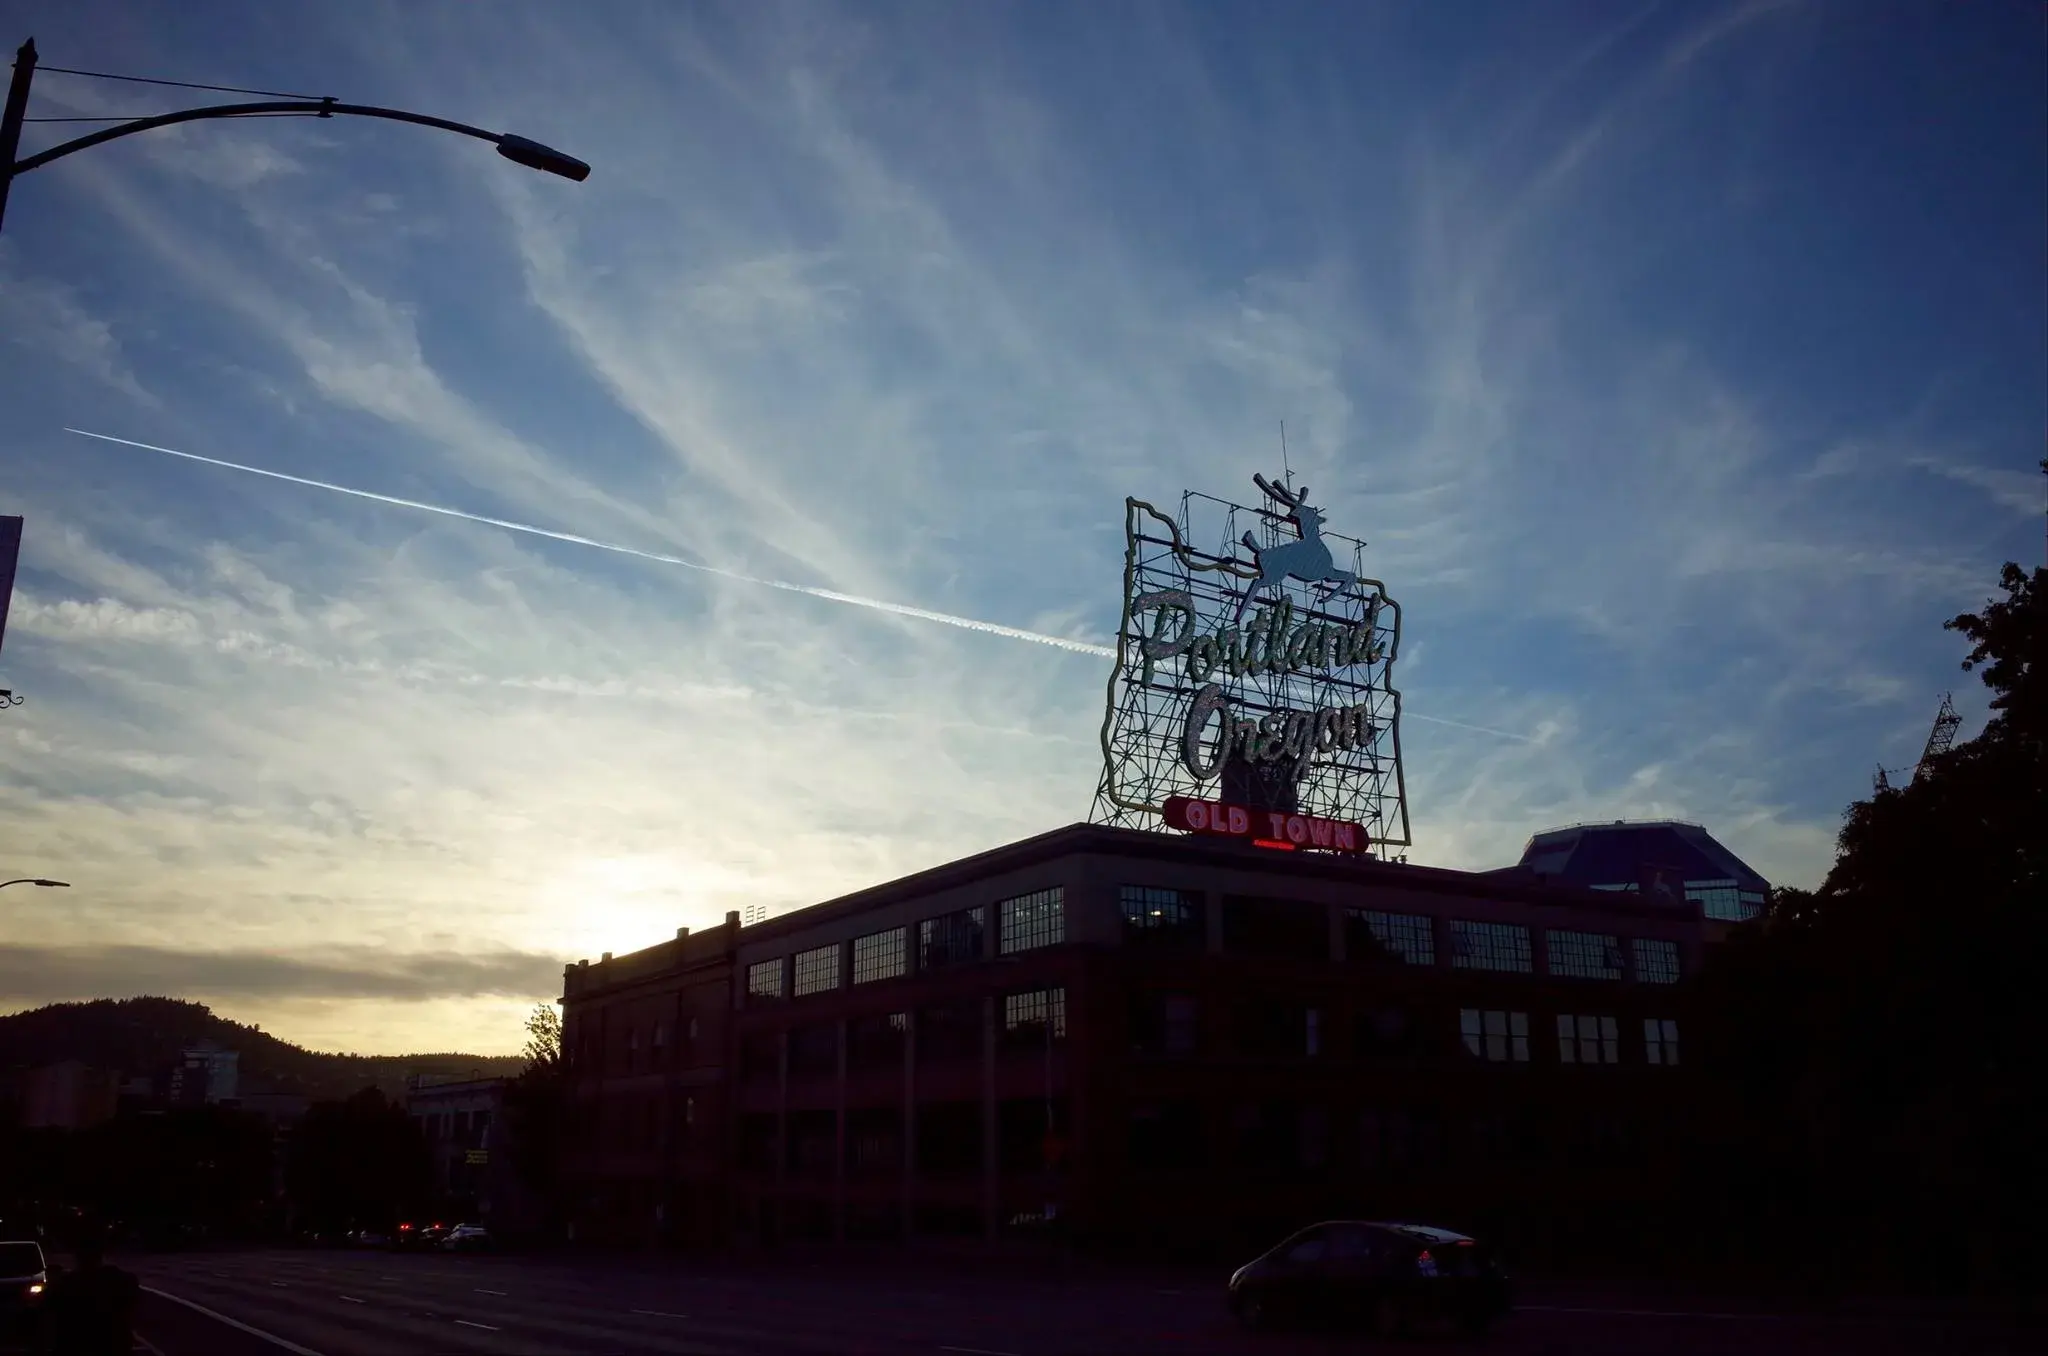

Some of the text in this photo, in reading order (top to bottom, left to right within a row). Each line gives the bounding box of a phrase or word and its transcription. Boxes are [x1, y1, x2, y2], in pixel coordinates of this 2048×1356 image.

[1131, 589, 1385, 688] Portland
[1182, 684, 1375, 783] Oregon
[1185, 800, 1355, 850] OLD TOWN
